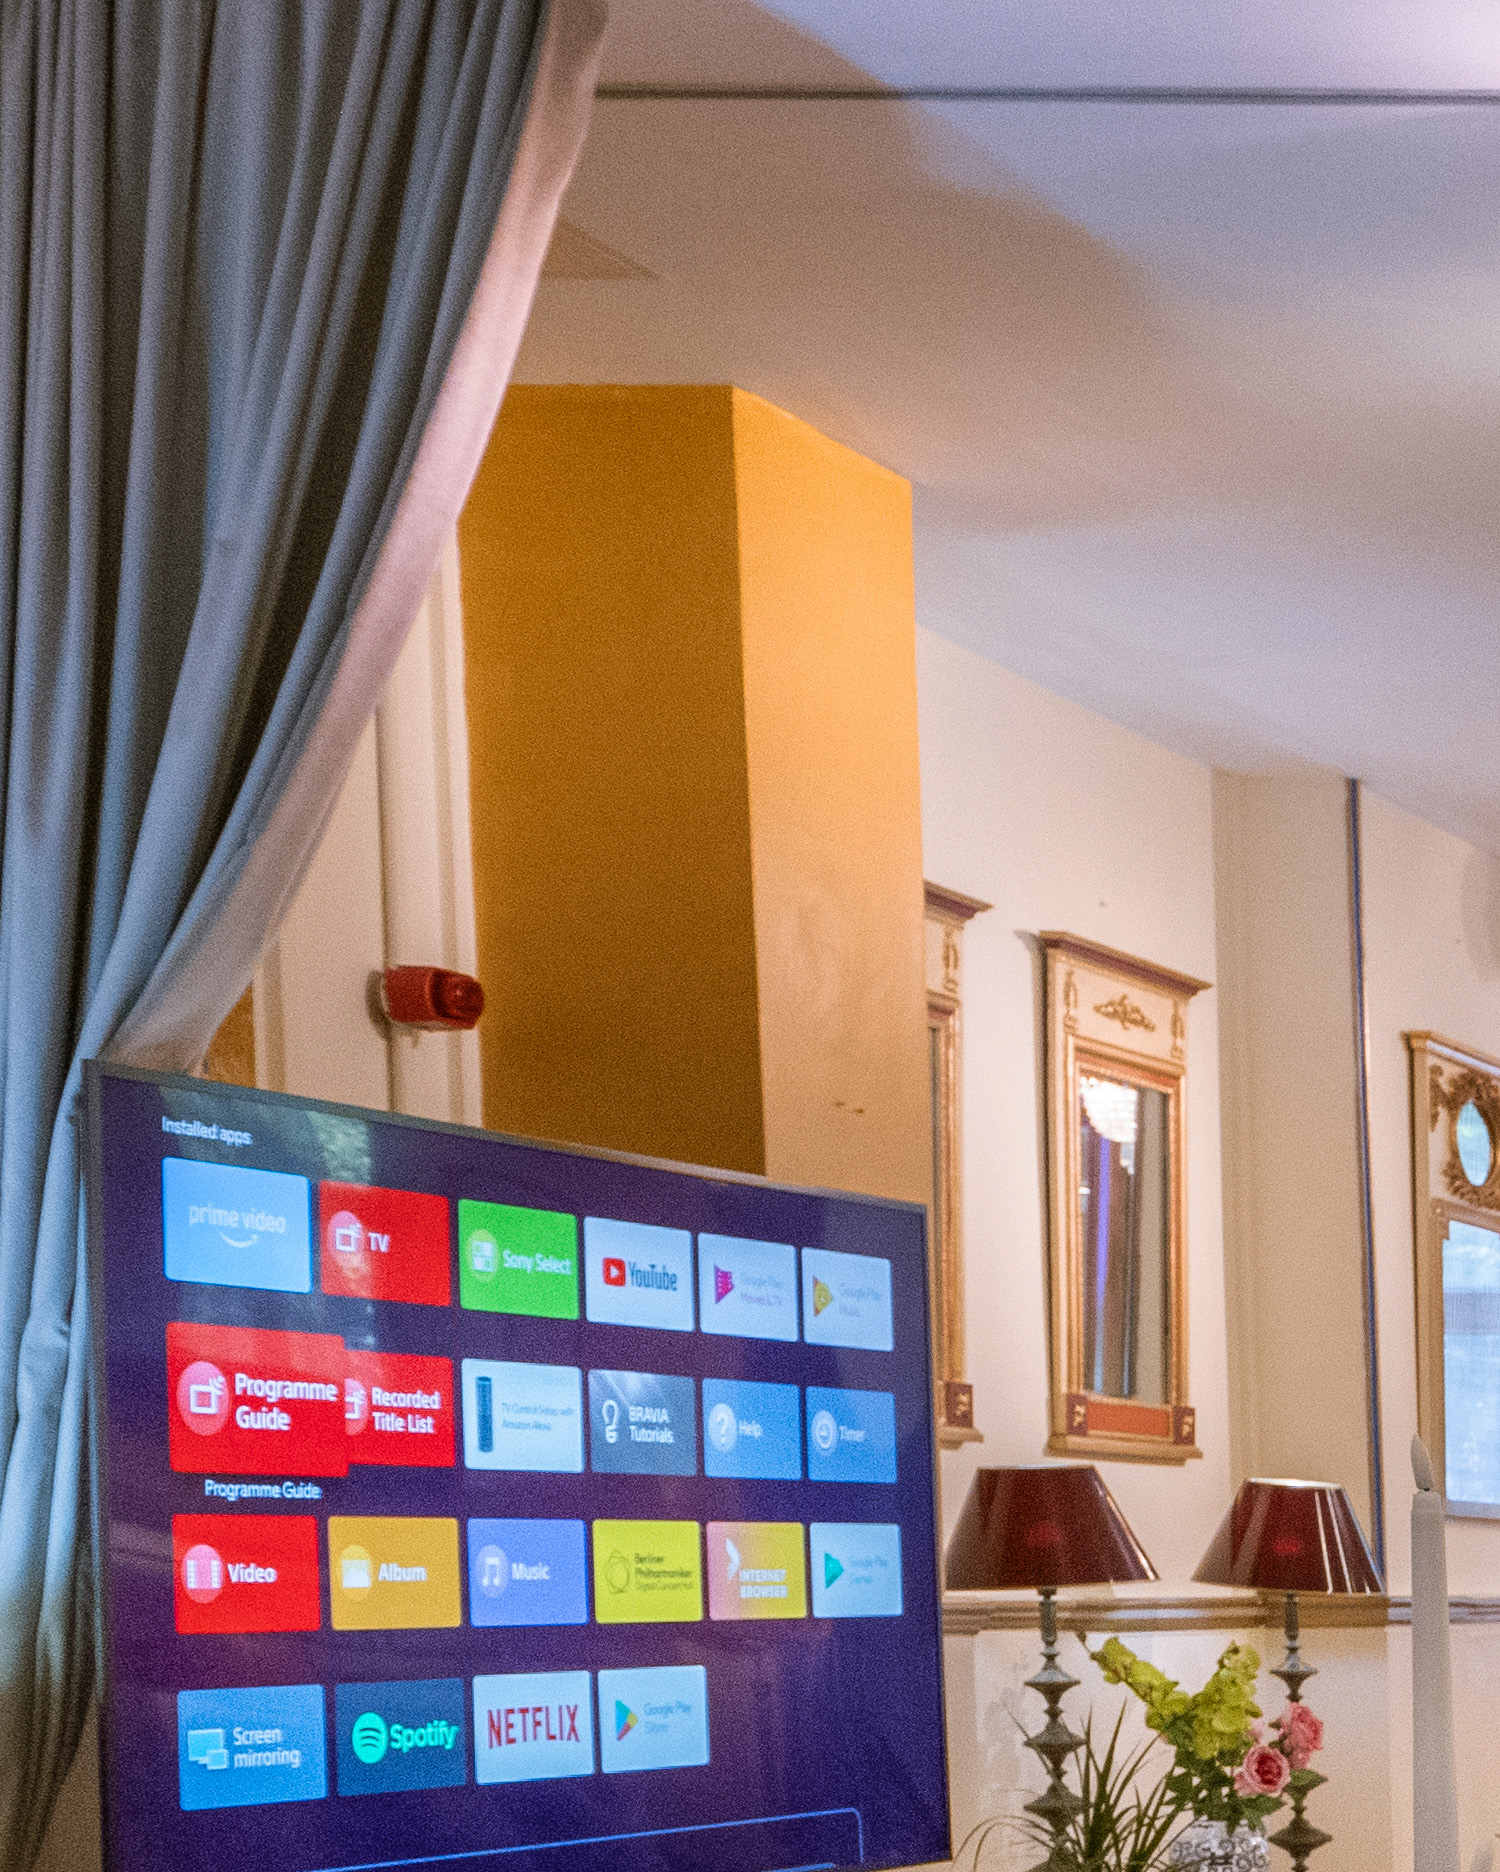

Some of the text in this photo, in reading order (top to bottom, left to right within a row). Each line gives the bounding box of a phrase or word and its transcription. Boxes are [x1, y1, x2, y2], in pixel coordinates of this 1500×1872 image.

[161, 1115, 252, 1147] Installed apps
[189, 1202, 287, 1233] prime video
[369, 1231, 390, 1253] TV
[502, 1249, 572, 1275] Sony Select
[628, 1260, 678, 1292] YouTube
[234, 1372, 338, 1403] Programme
[371, 1386, 441, 1410] Recorded
[235, 1405, 291, 1431] Guide
[372, 1411, 434, 1434] Title List
[629, 1405, 670, 1423] BRAVIA
[629, 1425, 675, 1443] Tutorials
[204, 1479, 323, 1502] Programme Guide
[227, 1562, 278, 1584] Video
[378, 1562, 427, 1582] Album
[511, 1562, 550, 1581] Music
[739, 1568, 787, 1582] INTERNET
[233, 1726, 282, 1746] Screen
[390, 1719, 460, 1753] Spotify
[487, 1704, 580, 1750] NETFLIX
[234, 1747, 300, 1768] mirroring
